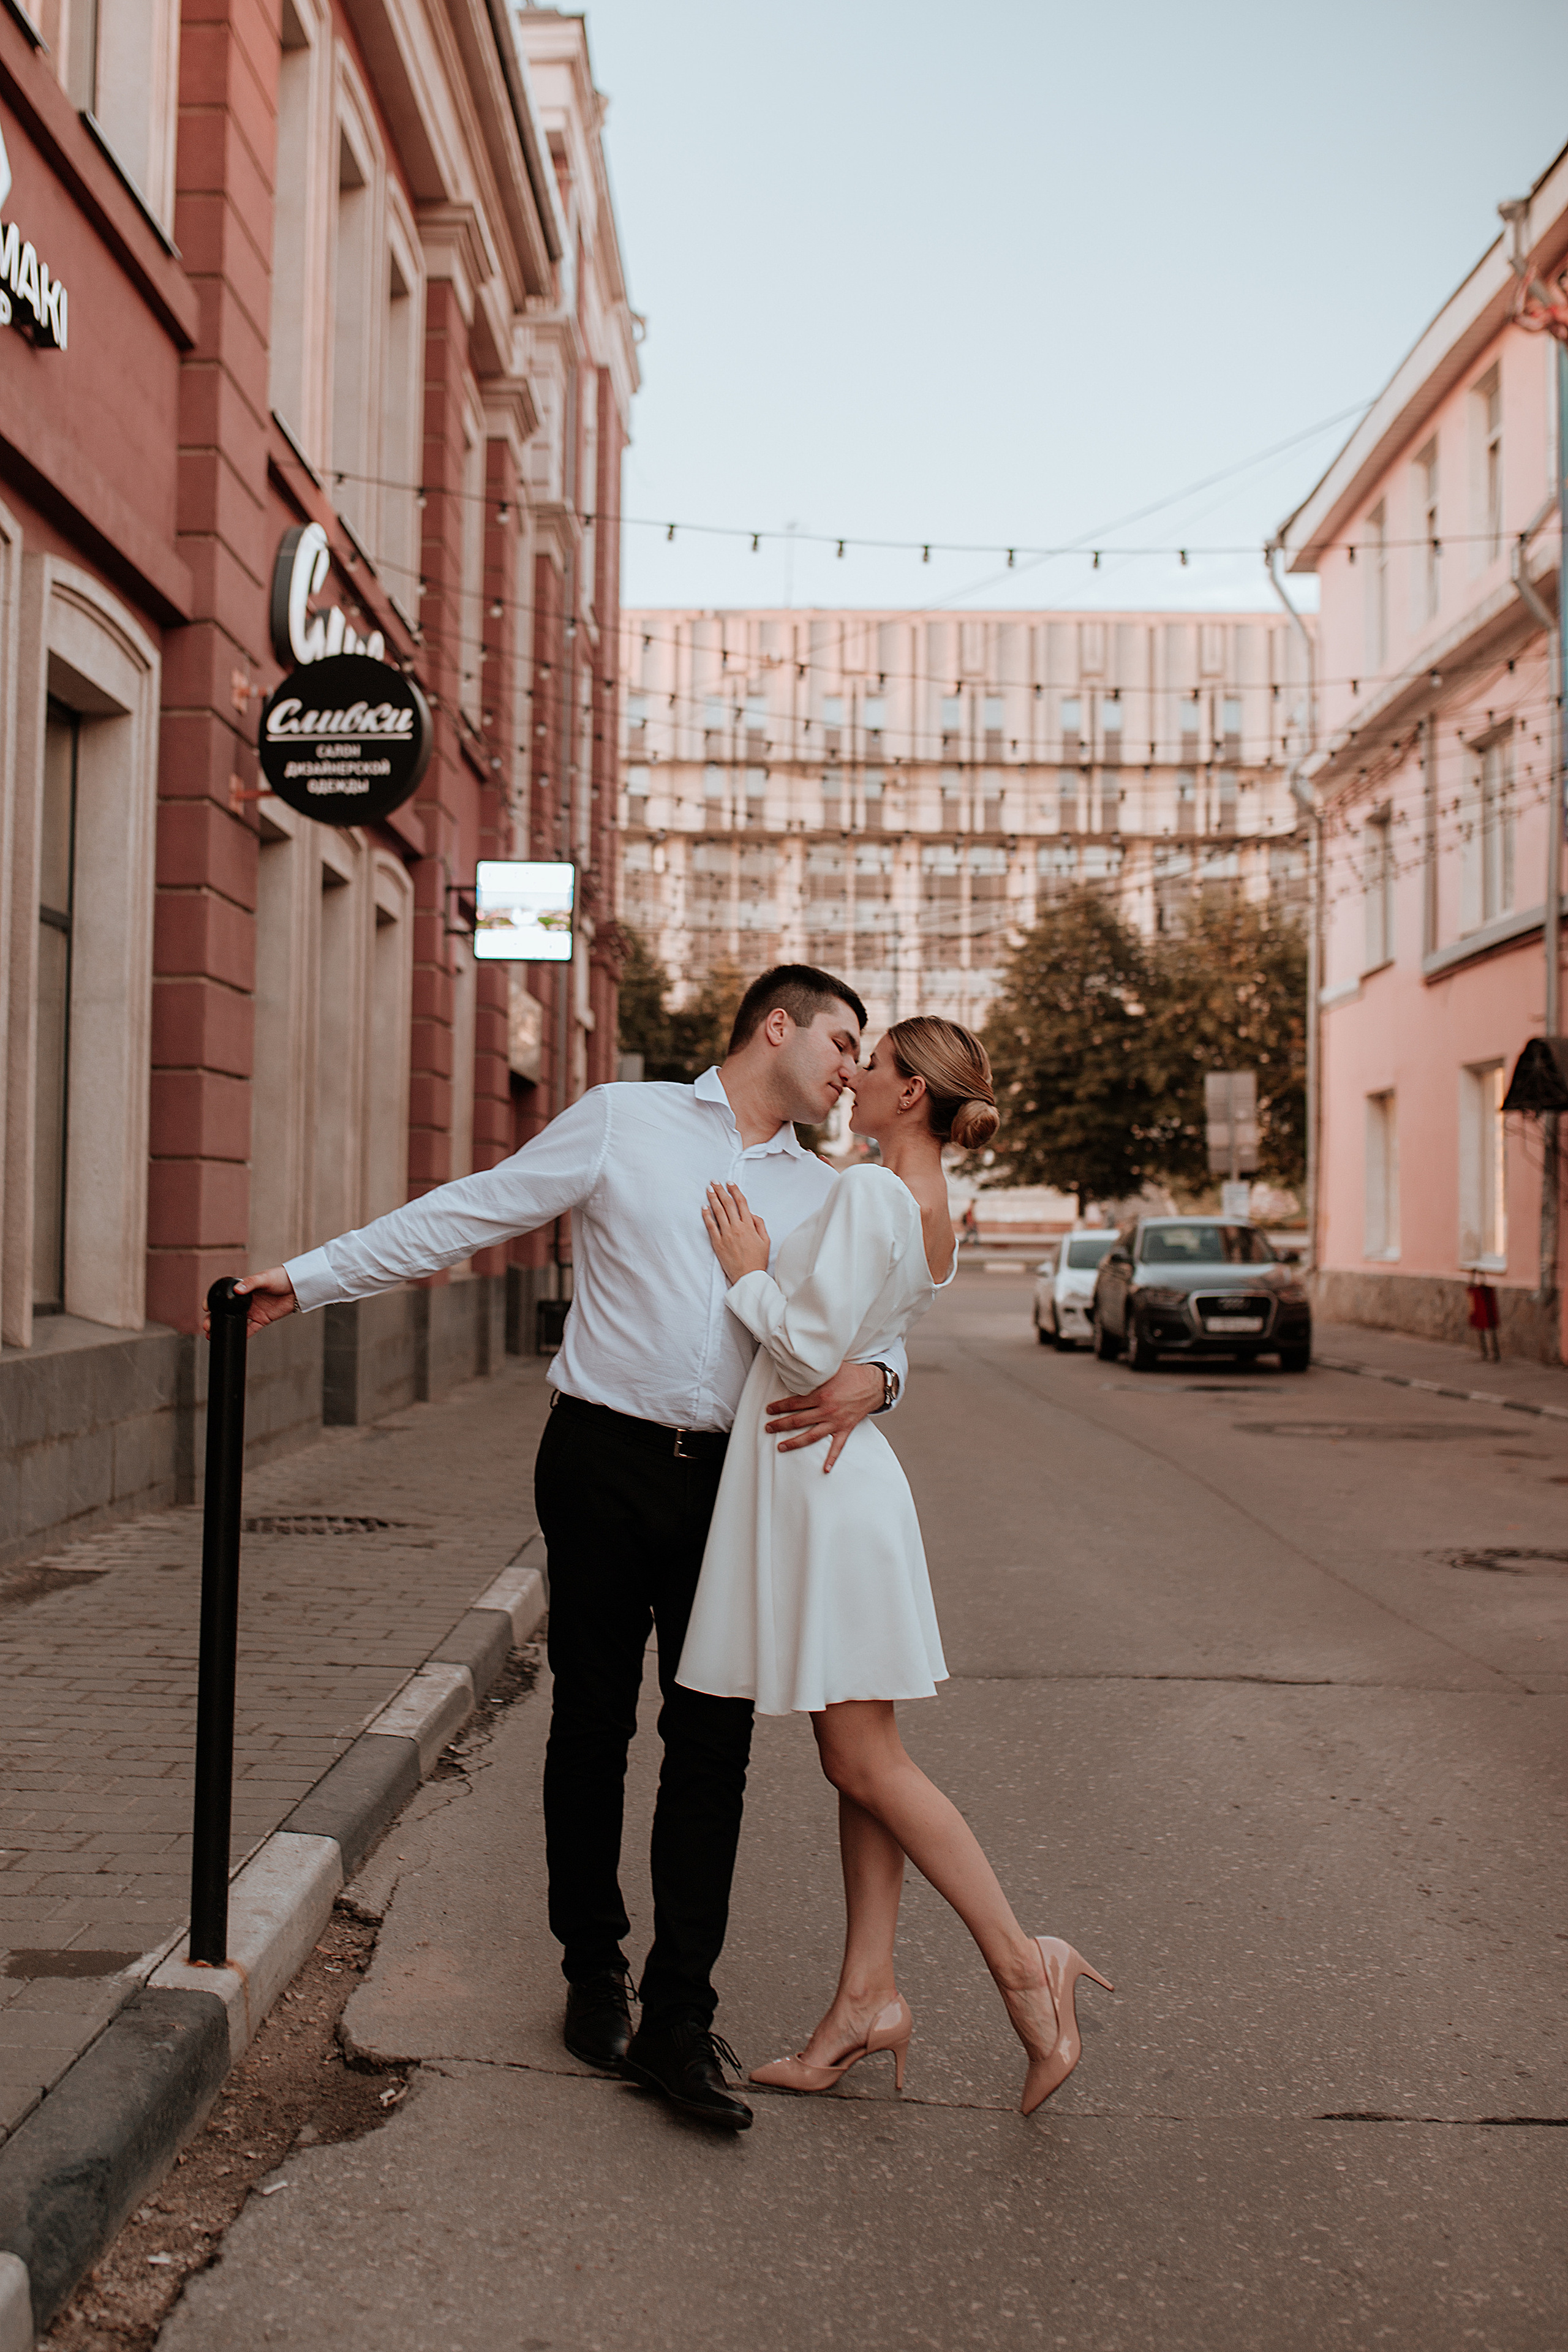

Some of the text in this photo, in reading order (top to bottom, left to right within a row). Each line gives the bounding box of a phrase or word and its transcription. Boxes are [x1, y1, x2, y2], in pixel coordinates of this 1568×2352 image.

[267, 698, 414, 734] Сливки
[316, 744, 361, 758] САЛОН
[284, 758, 391, 778] ДИЗАЙНЕРСКОЙ
[307, 778, 369, 795] ОДЕЖДЫ
